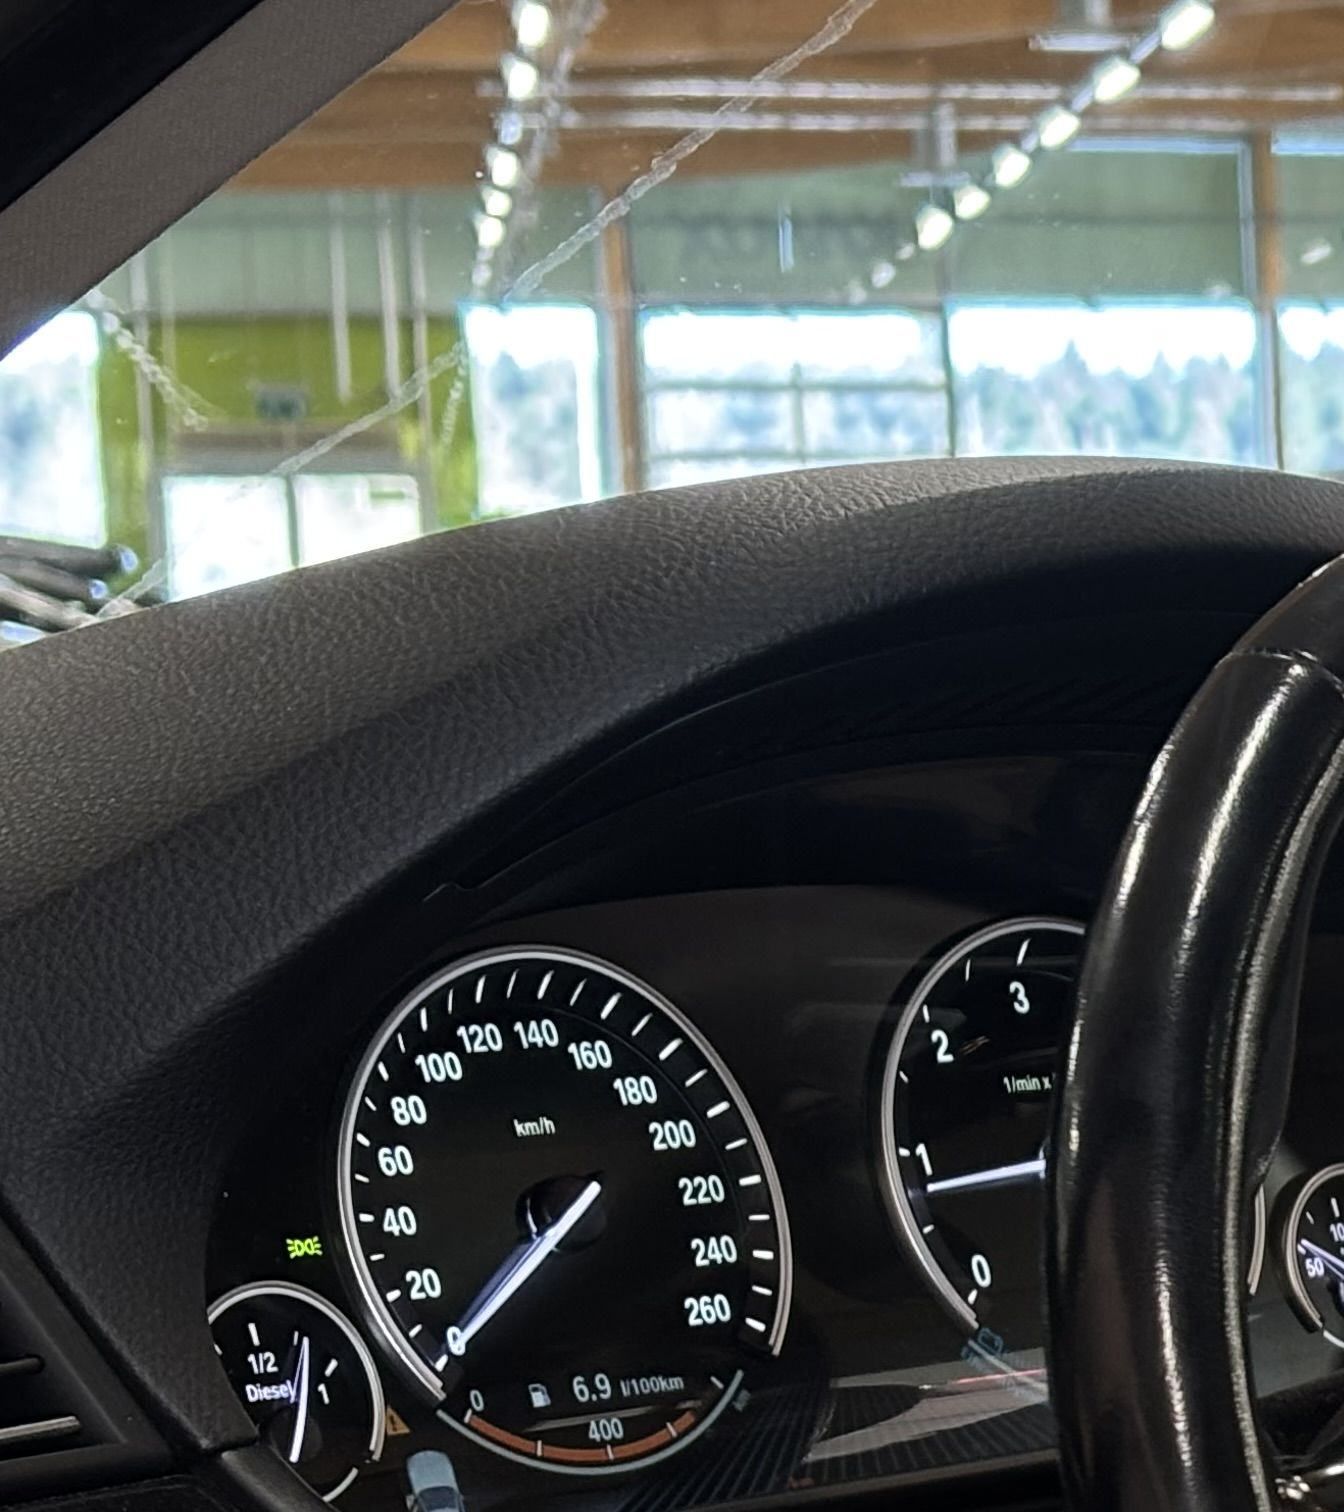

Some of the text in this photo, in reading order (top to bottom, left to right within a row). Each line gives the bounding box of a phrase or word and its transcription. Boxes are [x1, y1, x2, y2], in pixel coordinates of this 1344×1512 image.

[1010, 982, 1029, 1013] 3
[457, 1023, 502, 1054] 120
[514, 1019, 558, 1048] 140
[931, 1030, 953, 1062] 2
[415, 1052, 462, 1082] 100
[568, 1040, 612, 1069] 160
[614, 1076, 657, 1105] 180
[1003, 1074, 1041, 1094] 1/min
[391, 1095, 426, 1125] 80
[514, 1117, 555, 1136] km/h
[649, 1120, 696, 1150] 200
[378, 1146, 413, 1176] 60
[916, 1144, 932, 1175] 1
[679, 1175, 724, 1205] 220
[384, 1206, 416, 1236] 40
[691, 1235, 737, 1266] 240
[972, 1255, 991, 1288] 0
[1305, 1257, 1325, 1278] 50
[406, 1269, 441, 1299] 20
[684, 1294, 730, 1326] 260
[446, 1326, 467, 1356] 0
[248, 1351, 279, 1375] 1/2
[245, 1379, 295, 1403] Diesel
[317, 1382, 330, 1405] 1
[469, 1389, 484, 1412] 0
[572, 1373, 685, 1402] 6.9 l/100km
[588, 1417, 624, 1442] 400
